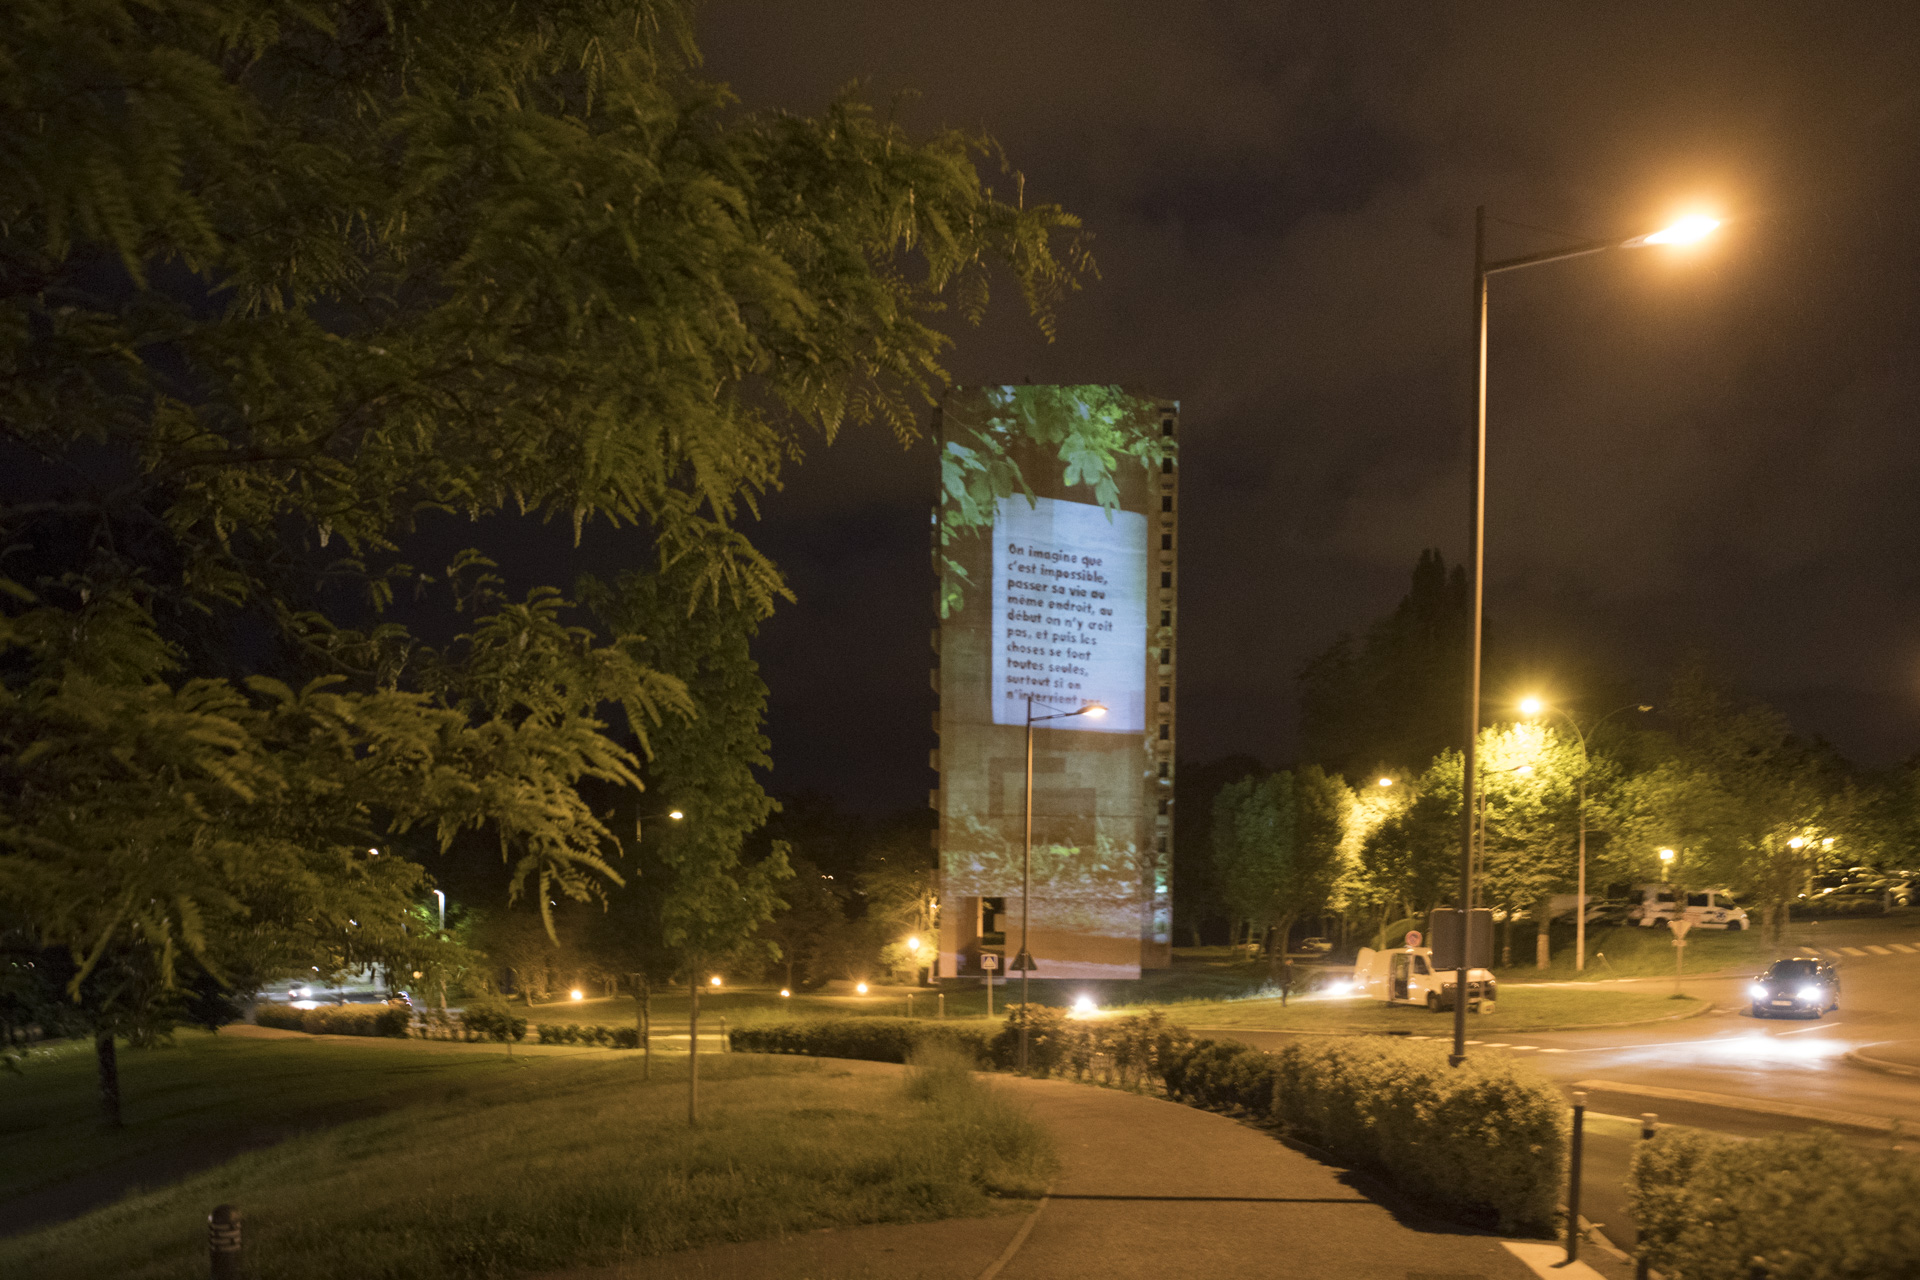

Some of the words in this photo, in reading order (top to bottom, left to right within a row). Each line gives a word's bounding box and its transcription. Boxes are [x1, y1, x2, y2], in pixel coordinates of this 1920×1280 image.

[1008, 543, 1024, 555] On
[1028, 546, 1078, 564] imagine
[1081, 555, 1103, 568] que
[1007, 560, 1036, 574] c'est
[1040, 564, 1108, 585] impossible,
[1007, 579, 1048, 591] passer
[1051, 584, 1066, 595] sa
[1069, 585, 1087, 597] vie
[1091, 590, 1106, 600] au
[1007, 594, 1044, 607] même
[1048, 600, 1095, 616] endroit,
[1099, 607, 1113, 616] au
[1007, 608, 1042, 623] début
[1046, 616, 1061, 626] on
[1064, 617, 1084, 631] n'y
[1088, 621, 1113, 632] croit
[1007, 628, 1032, 639] pas,
[1035, 630, 1048, 639] et
[1052, 631, 1077, 643] puis
[1080, 633, 1097, 645] les
[1006, 641, 1045, 656] choses
[1049, 649, 1062, 657] se
[1066, 647, 1092, 660] font
[1006, 657, 1045, 671] toutes
[1006, 675, 1051, 687] surtout
[1053, 678, 1064, 688] si
